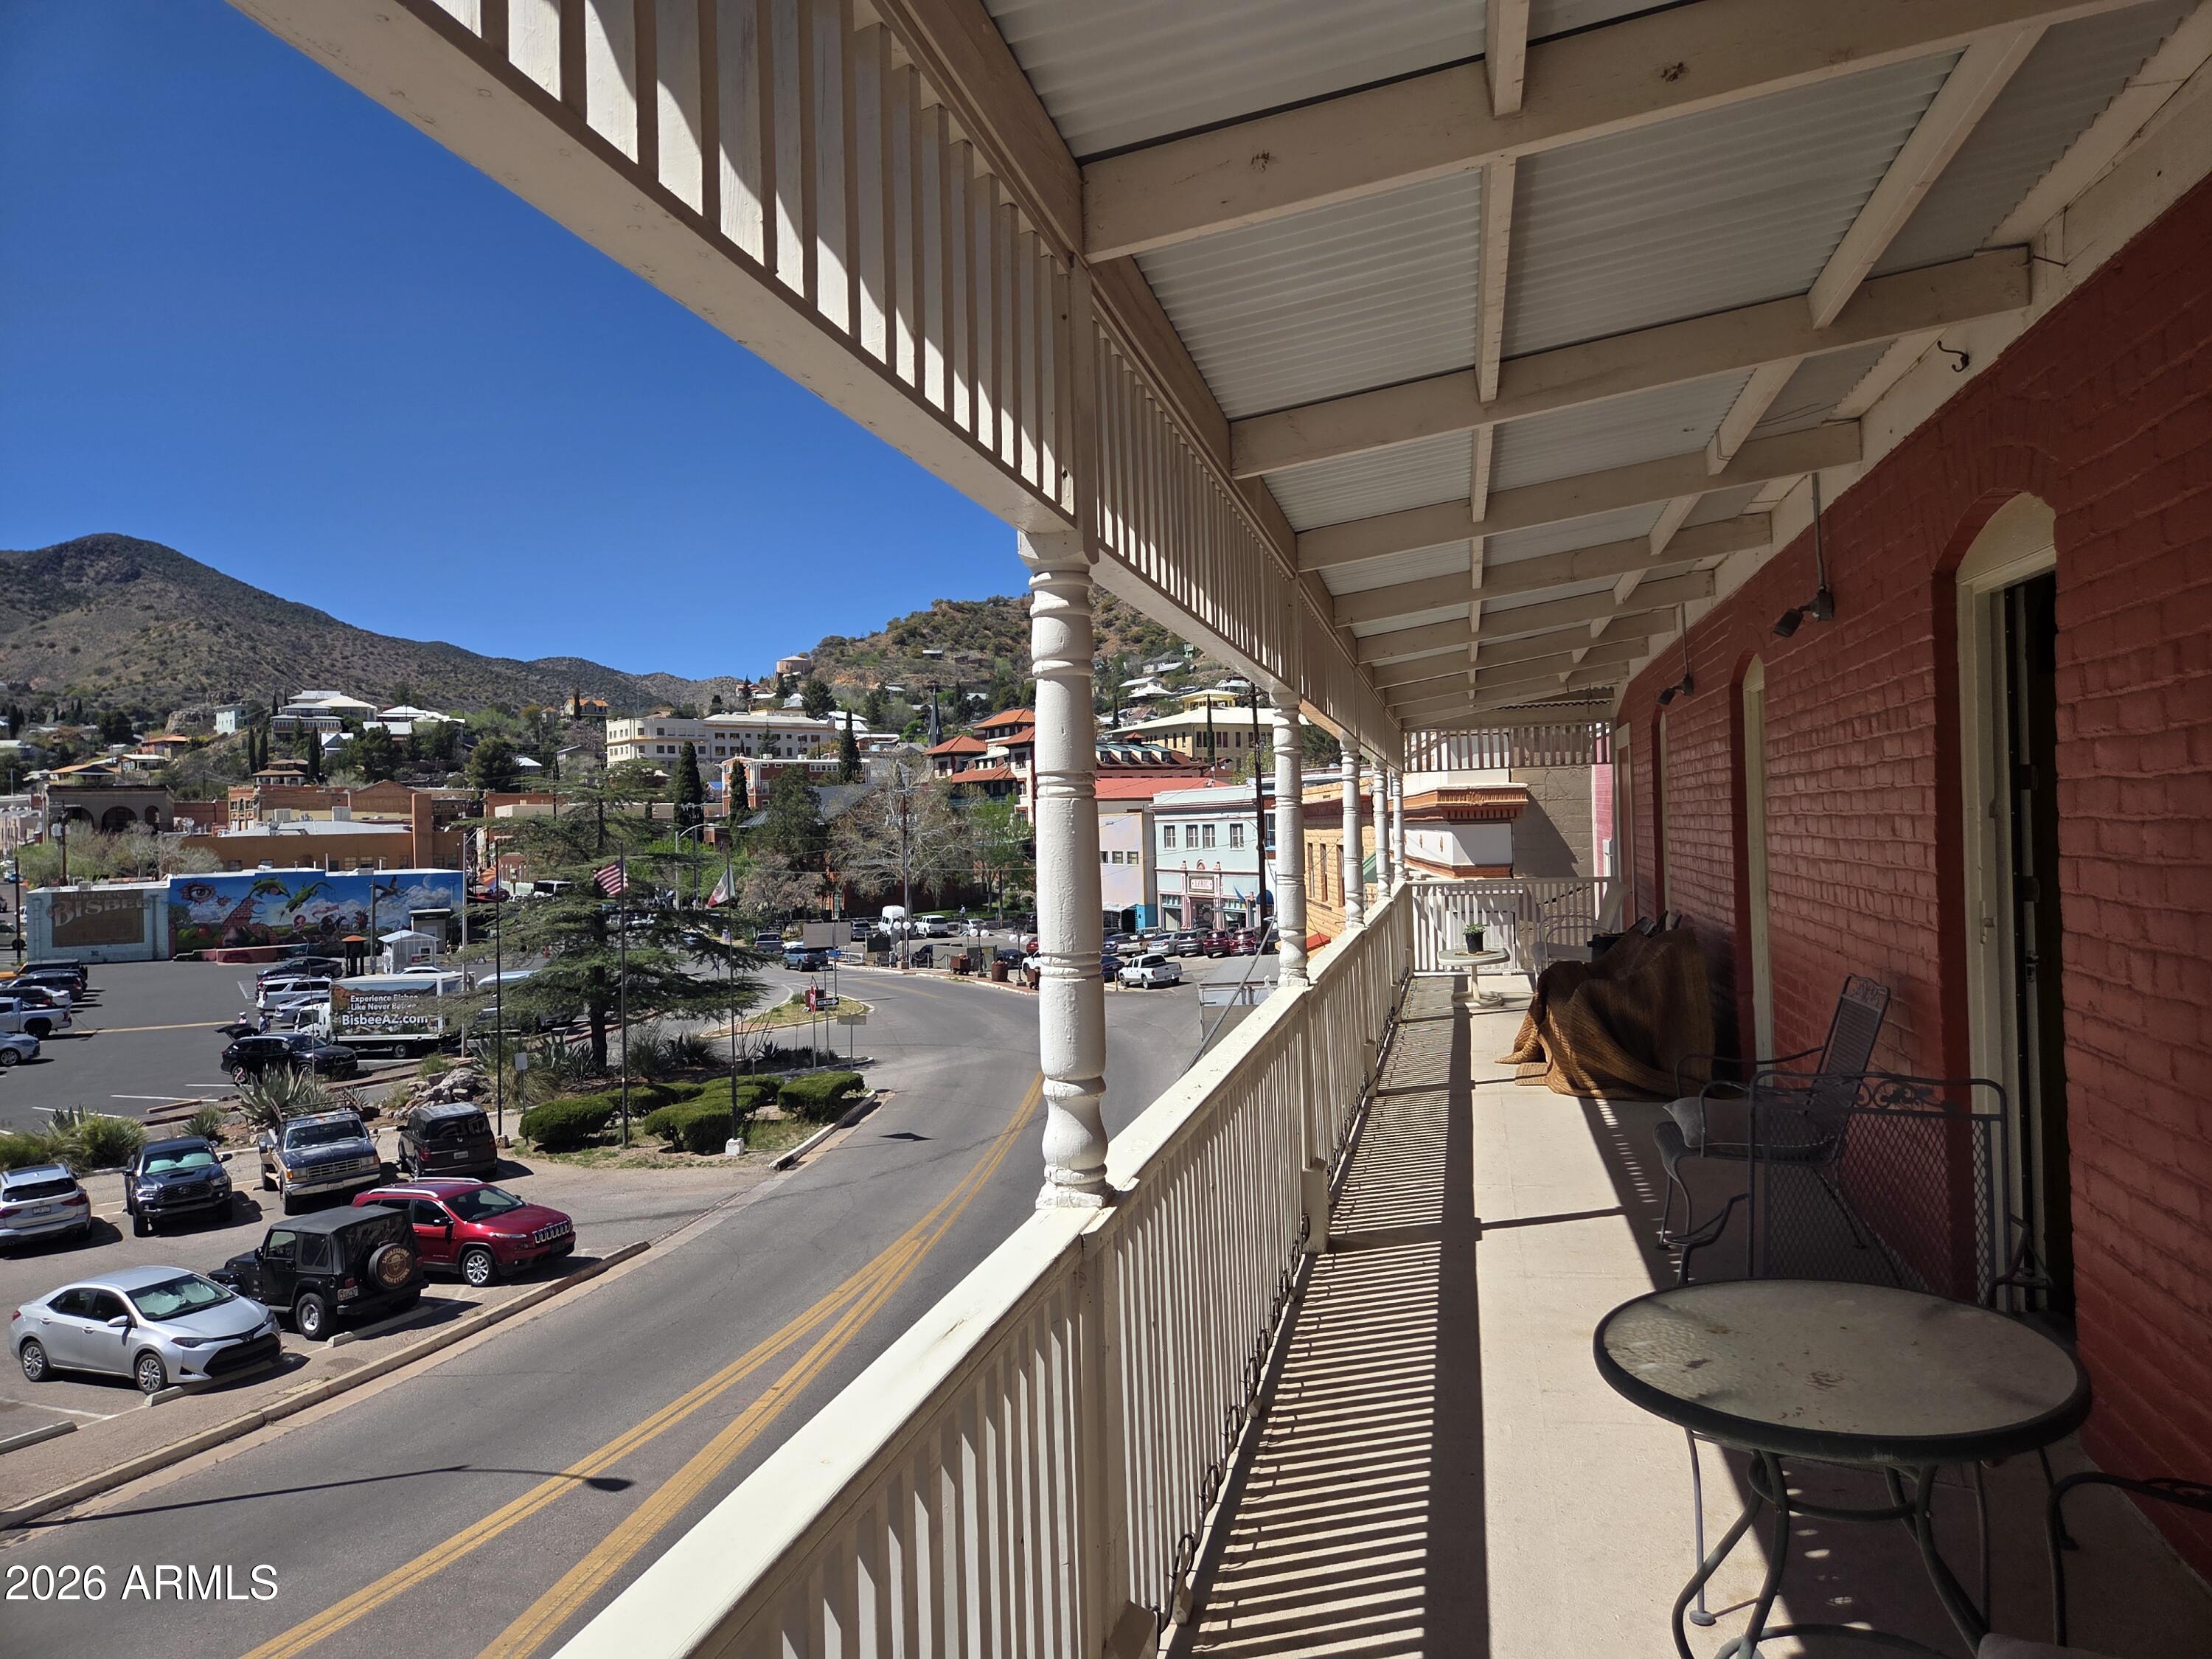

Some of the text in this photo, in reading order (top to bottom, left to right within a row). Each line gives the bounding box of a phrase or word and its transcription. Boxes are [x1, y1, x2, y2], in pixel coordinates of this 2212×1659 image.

[46, 897, 152, 928] BISBEE
[350, 995, 392, 1004] Experience
[341, 1013, 428, 1026] BisbeeAZ.com
